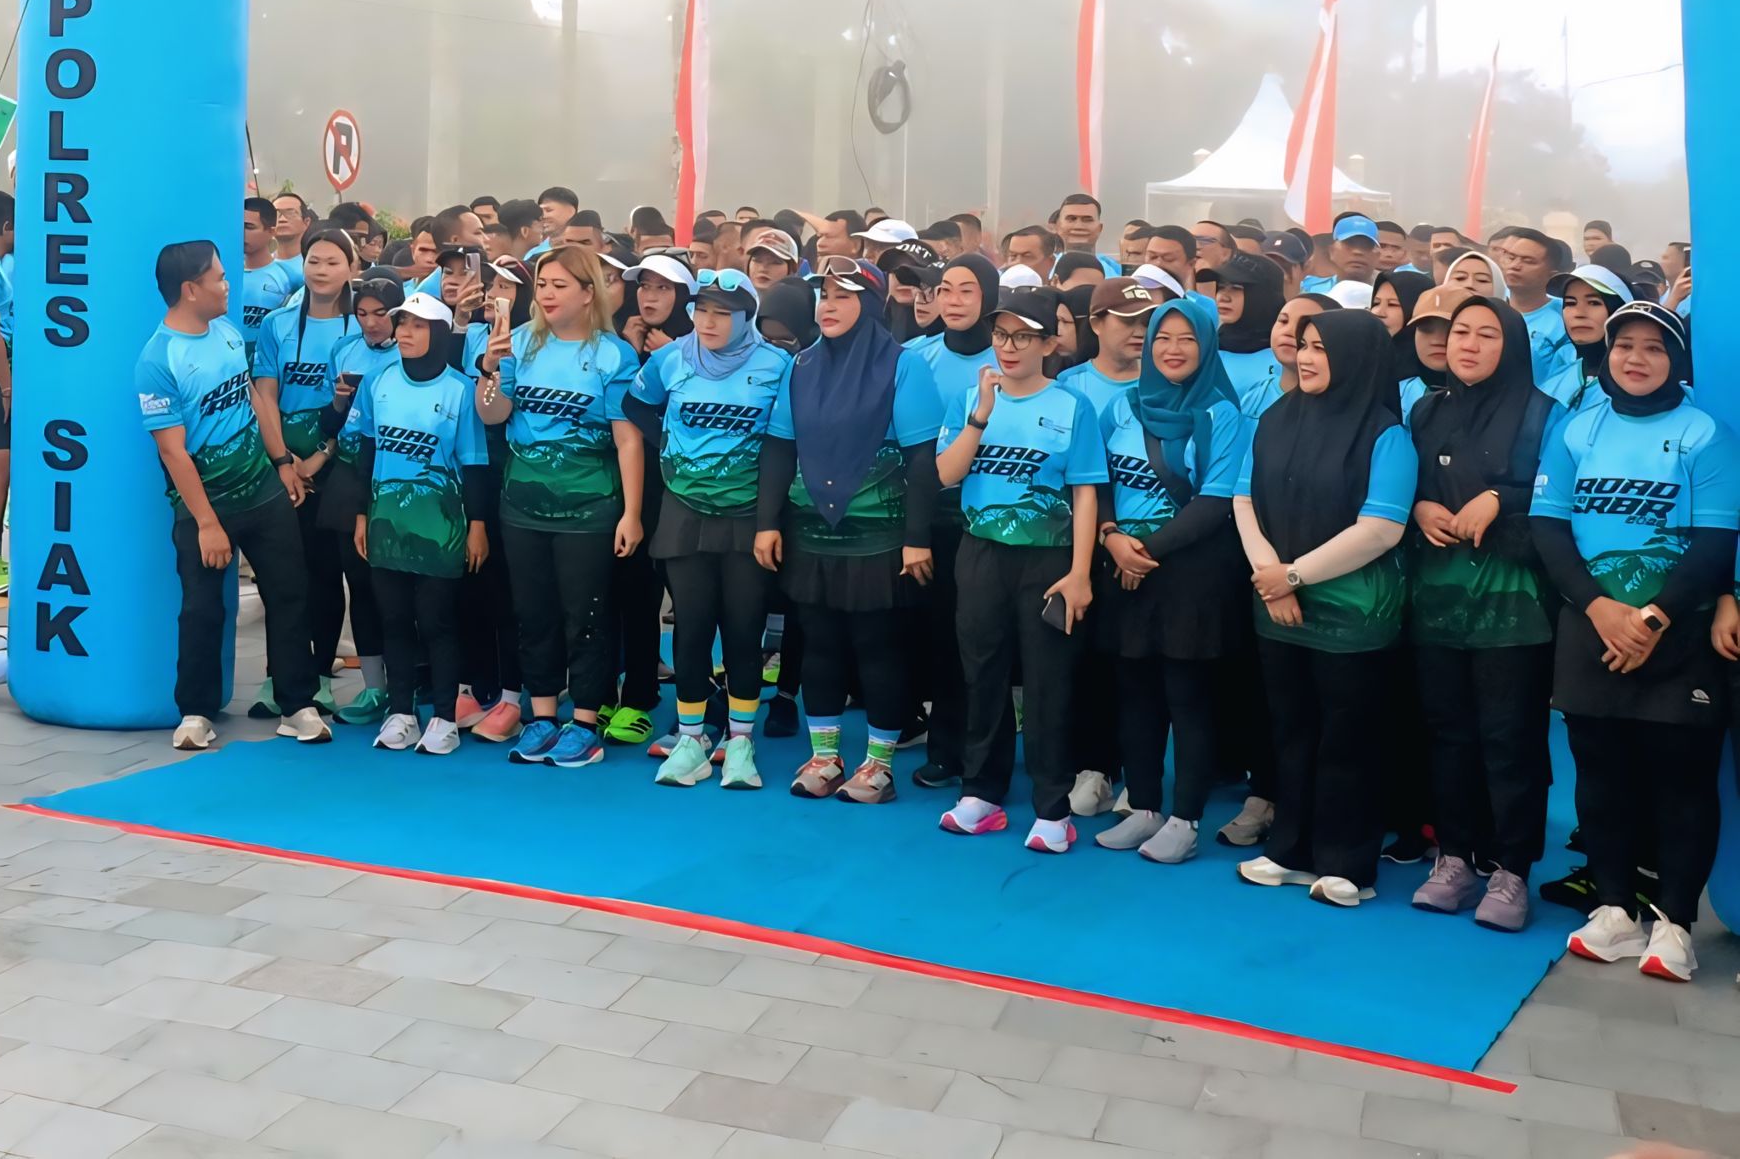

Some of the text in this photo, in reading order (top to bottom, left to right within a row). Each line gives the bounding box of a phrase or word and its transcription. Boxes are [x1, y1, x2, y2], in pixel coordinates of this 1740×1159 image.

[284, 362, 328, 374] ROA
[515, 385, 596, 407] ROAD
[680, 401, 763, 418] ROAD
[1574, 477, 1681, 500] ROAD
[35, 419, 92, 658] SIAK
